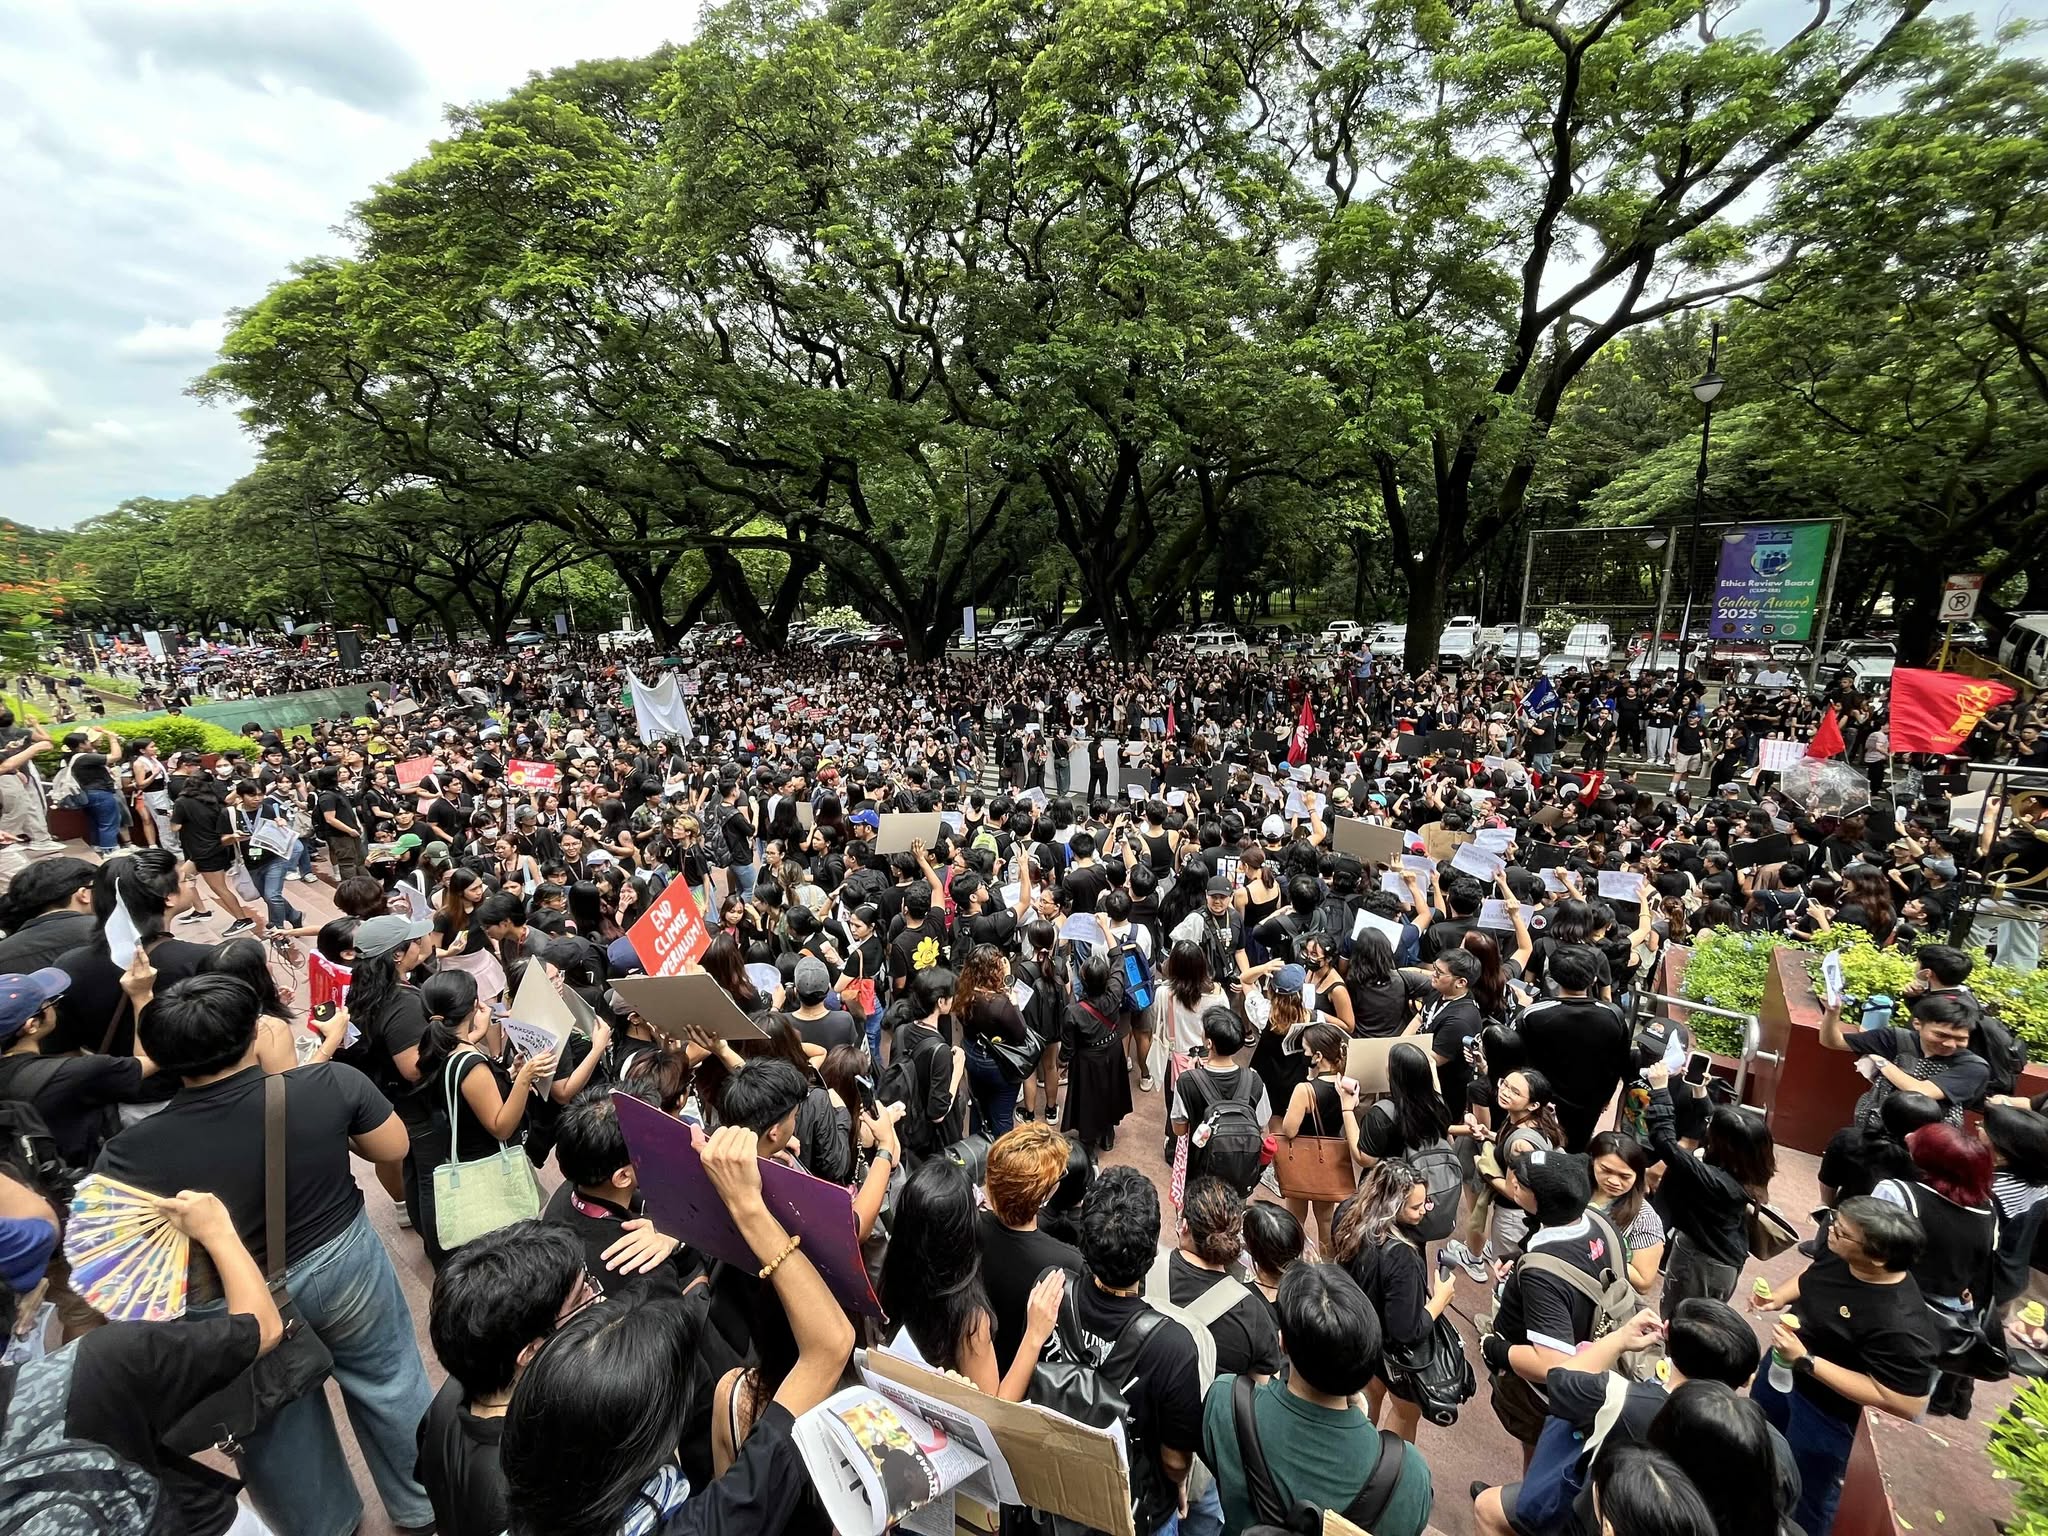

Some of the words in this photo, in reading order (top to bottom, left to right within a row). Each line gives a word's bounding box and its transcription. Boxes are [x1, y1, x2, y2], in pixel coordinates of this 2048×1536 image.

[1784, 579, 1815, 587] Board
[1718, 595, 1760, 610] Galing
[1763, 595, 1810, 608] Award
[1717, 608, 1758, 619] 2025
[650, 899, 672, 932] END
[654, 908, 689, 955] CLIMATE
